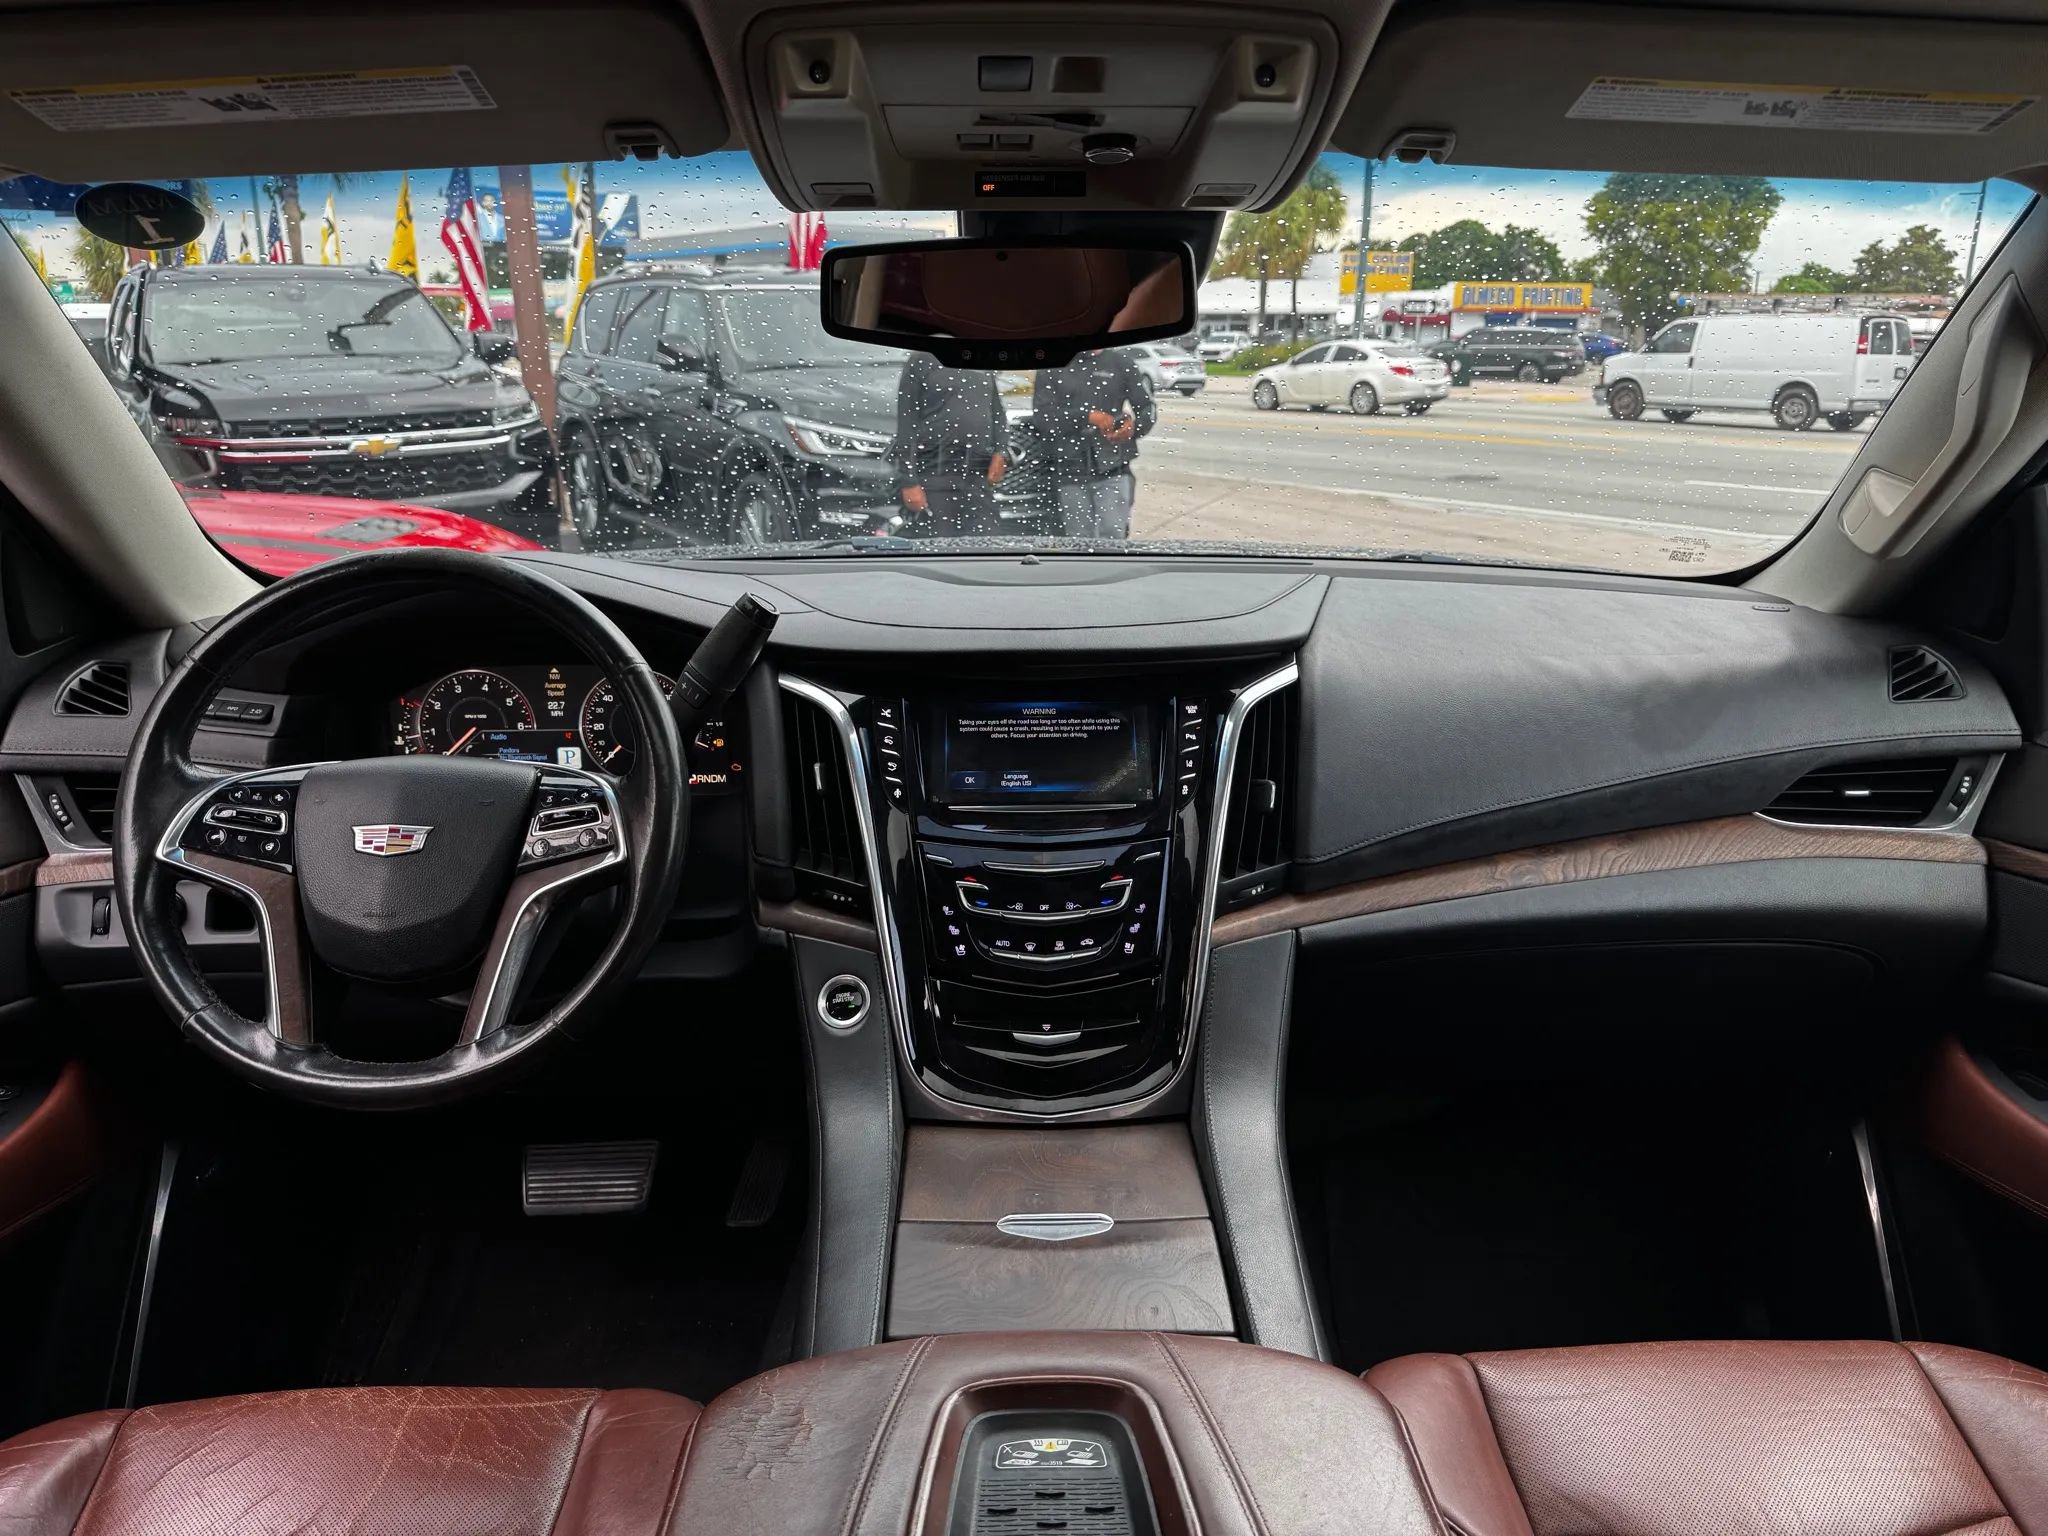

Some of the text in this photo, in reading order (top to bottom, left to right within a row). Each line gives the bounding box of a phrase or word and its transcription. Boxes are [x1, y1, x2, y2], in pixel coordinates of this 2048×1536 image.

[1523, 287, 1582, 305] PRINTING
[454, 684, 462, 694] 3
[482, 683, 489, 692] 4
[434, 702, 442, 710] 2
[506, 698, 514, 706] 5
[548, 701, 566, 710] 22.7
[516, 722, 524, 730] 6
[430, 728, 436, 736] 1
